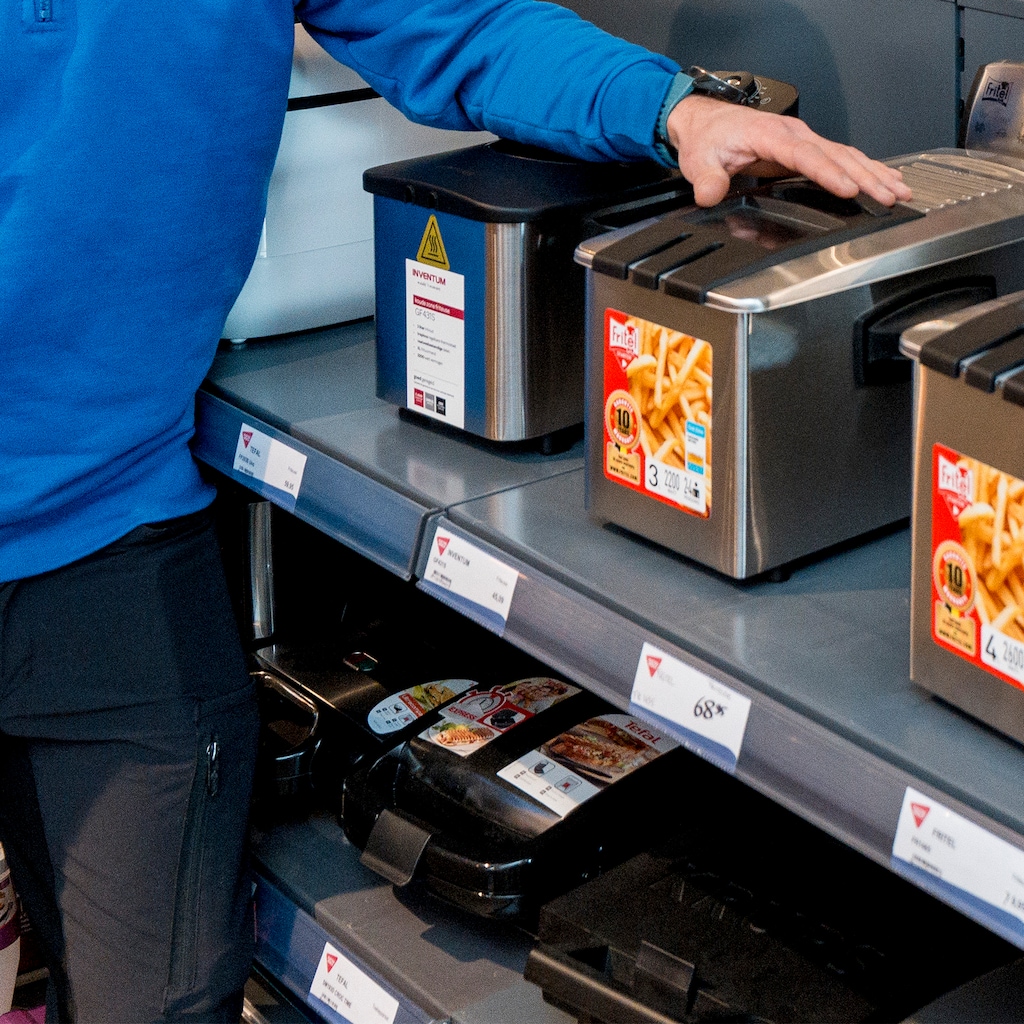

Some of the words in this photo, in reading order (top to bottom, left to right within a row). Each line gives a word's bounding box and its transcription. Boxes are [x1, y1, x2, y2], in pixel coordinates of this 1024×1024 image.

[412, 268, 446, 286] INVENTUM
[612, 326, 637, 350] Fritel
[617, 408, 630, 429] 10
[649, 464, 659, 487] 3
[664, 469, 680, 490] 2200
[941, 465, 972, 497] Fritel
[448, 549, 470, 566] INVENTUM
[947, 562, 963, 587] 10
[985, 634, 997, 662] 4
[1003, 640, 1024, 669] 2600
[449, 707, 477, 720] EXPRESS
[624, 720, 661, 745] Tefal
[931, 828, 956, 850] FRITEL
